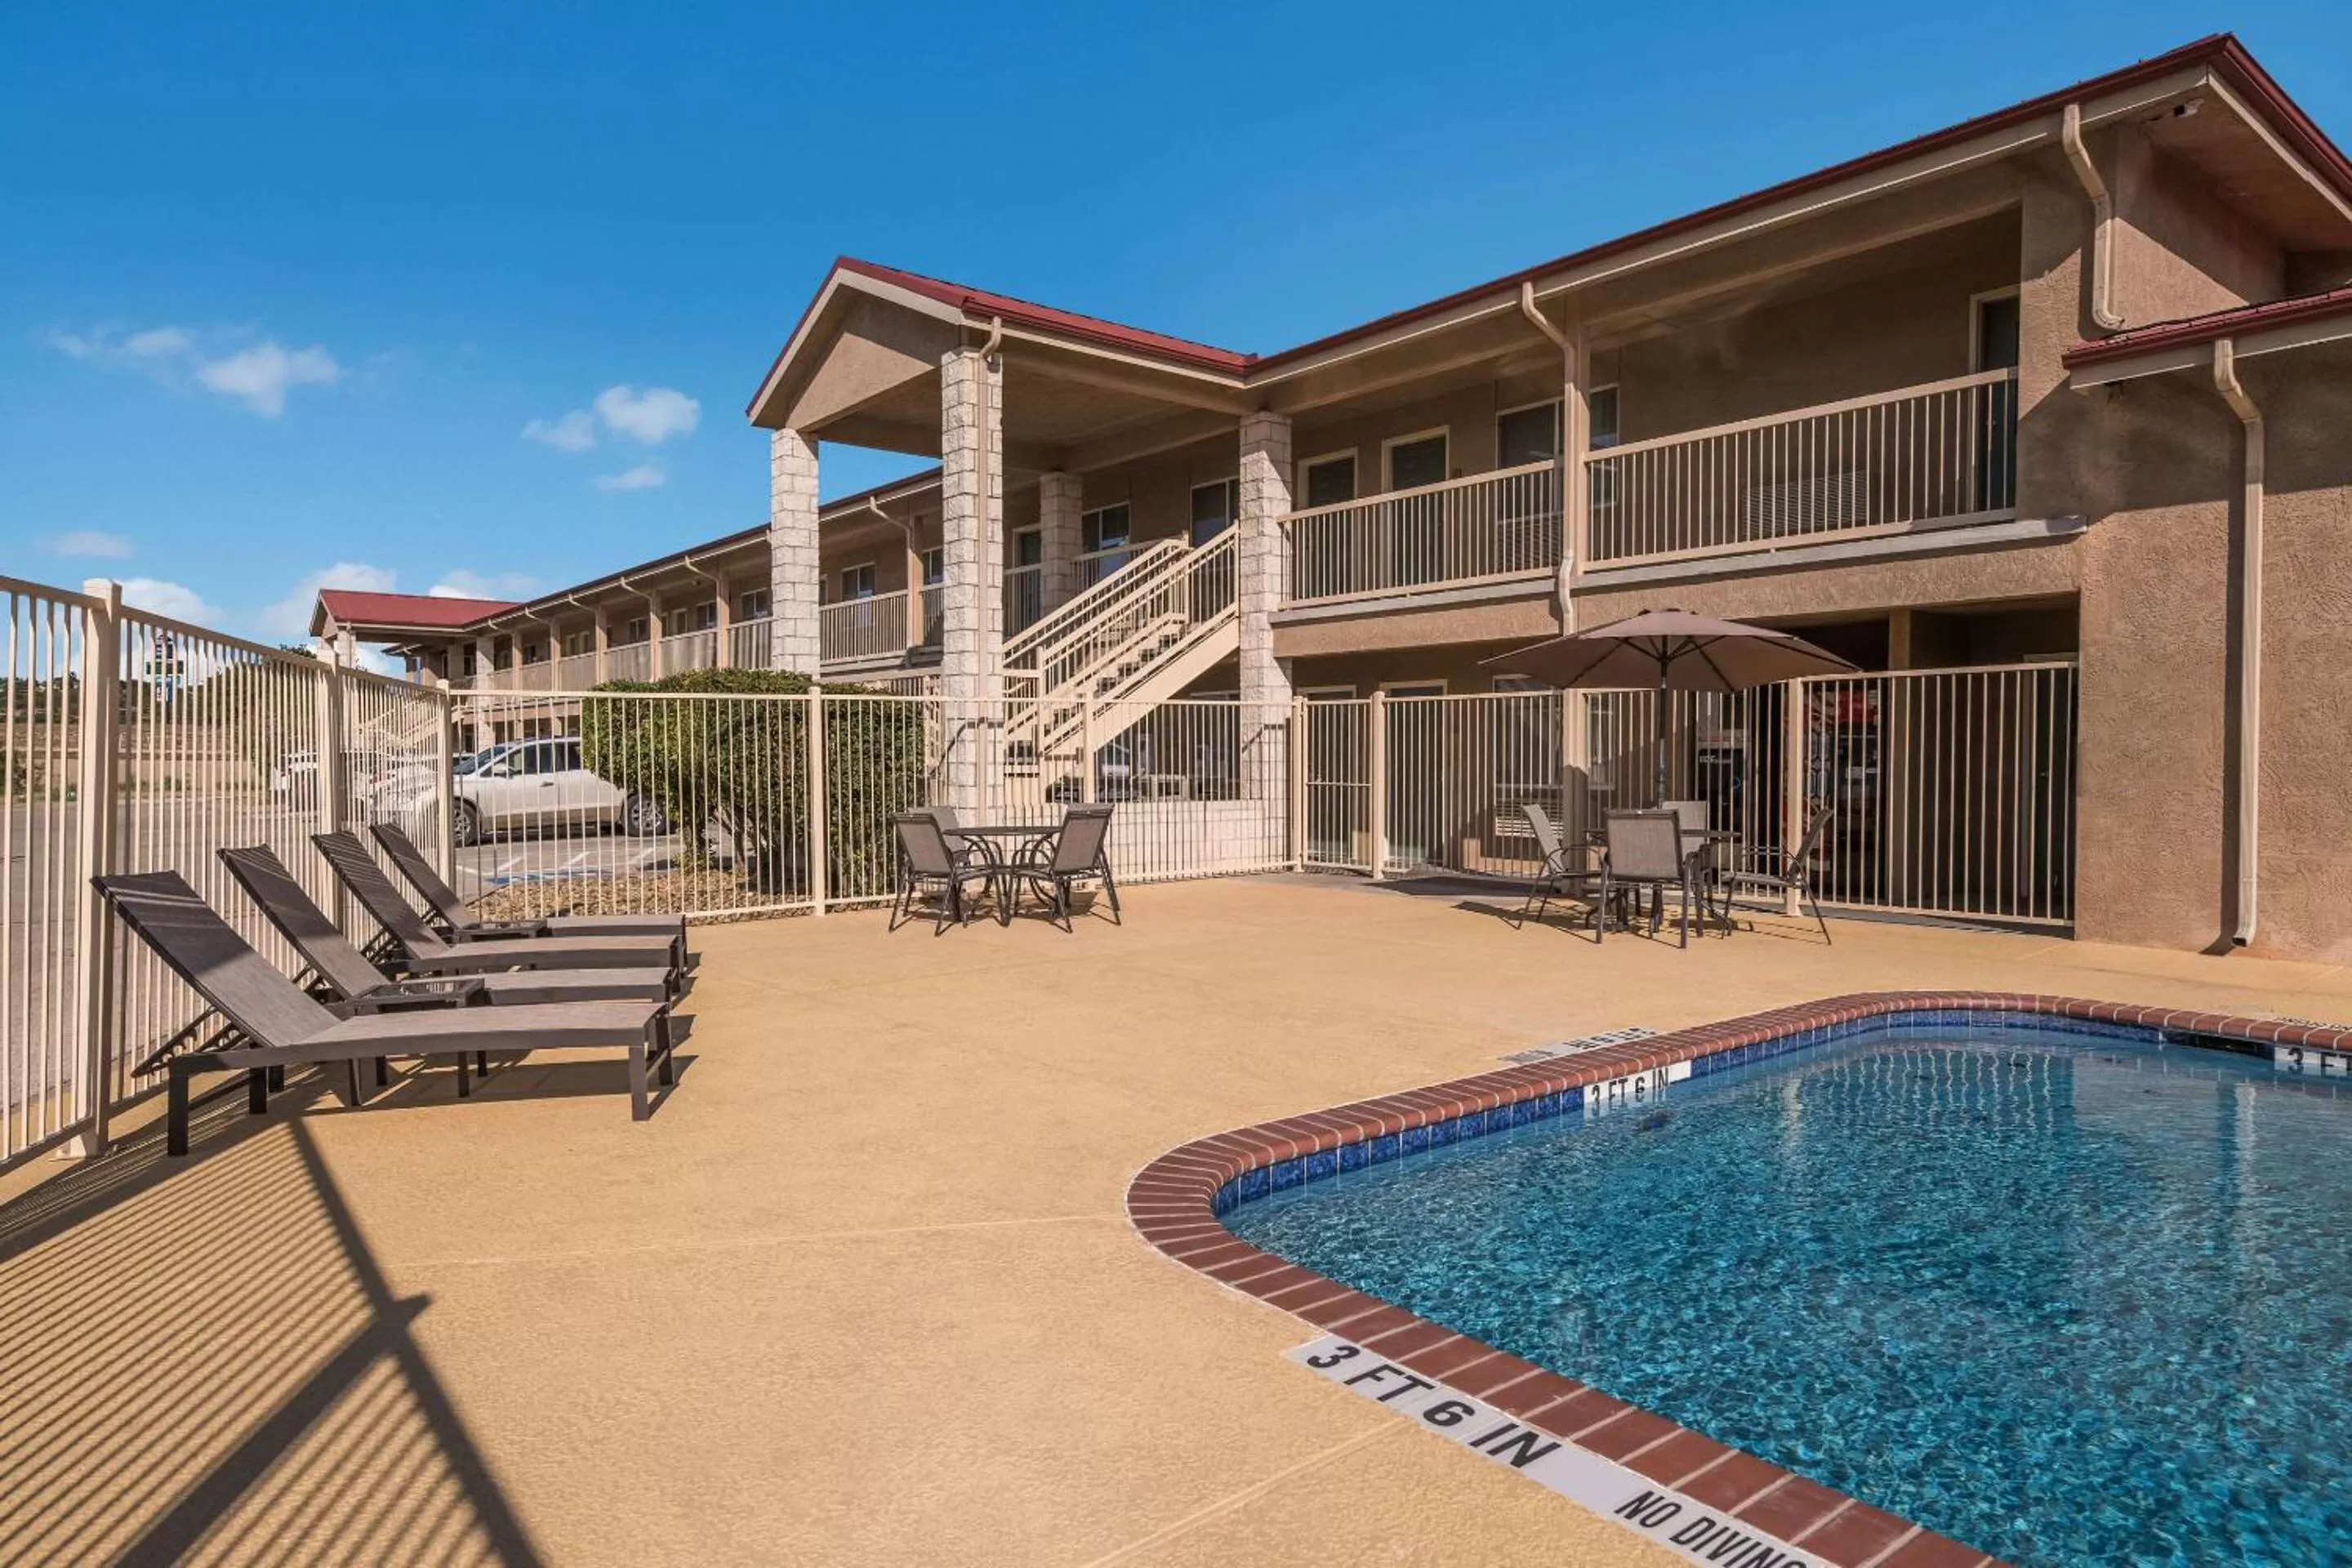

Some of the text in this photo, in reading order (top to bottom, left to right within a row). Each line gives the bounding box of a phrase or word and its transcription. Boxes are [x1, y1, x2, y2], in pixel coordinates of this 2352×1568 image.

[1609, 1079, 1628, 1102] FT
[1635, 1076, 1646, 1094] 6
[1652, 1067, 1668, 1092] IN
[1307, 1345, 1561, 1468] 3 FT 6 IN
[1614, 1490, 1806, 1568] NO DIVIN
